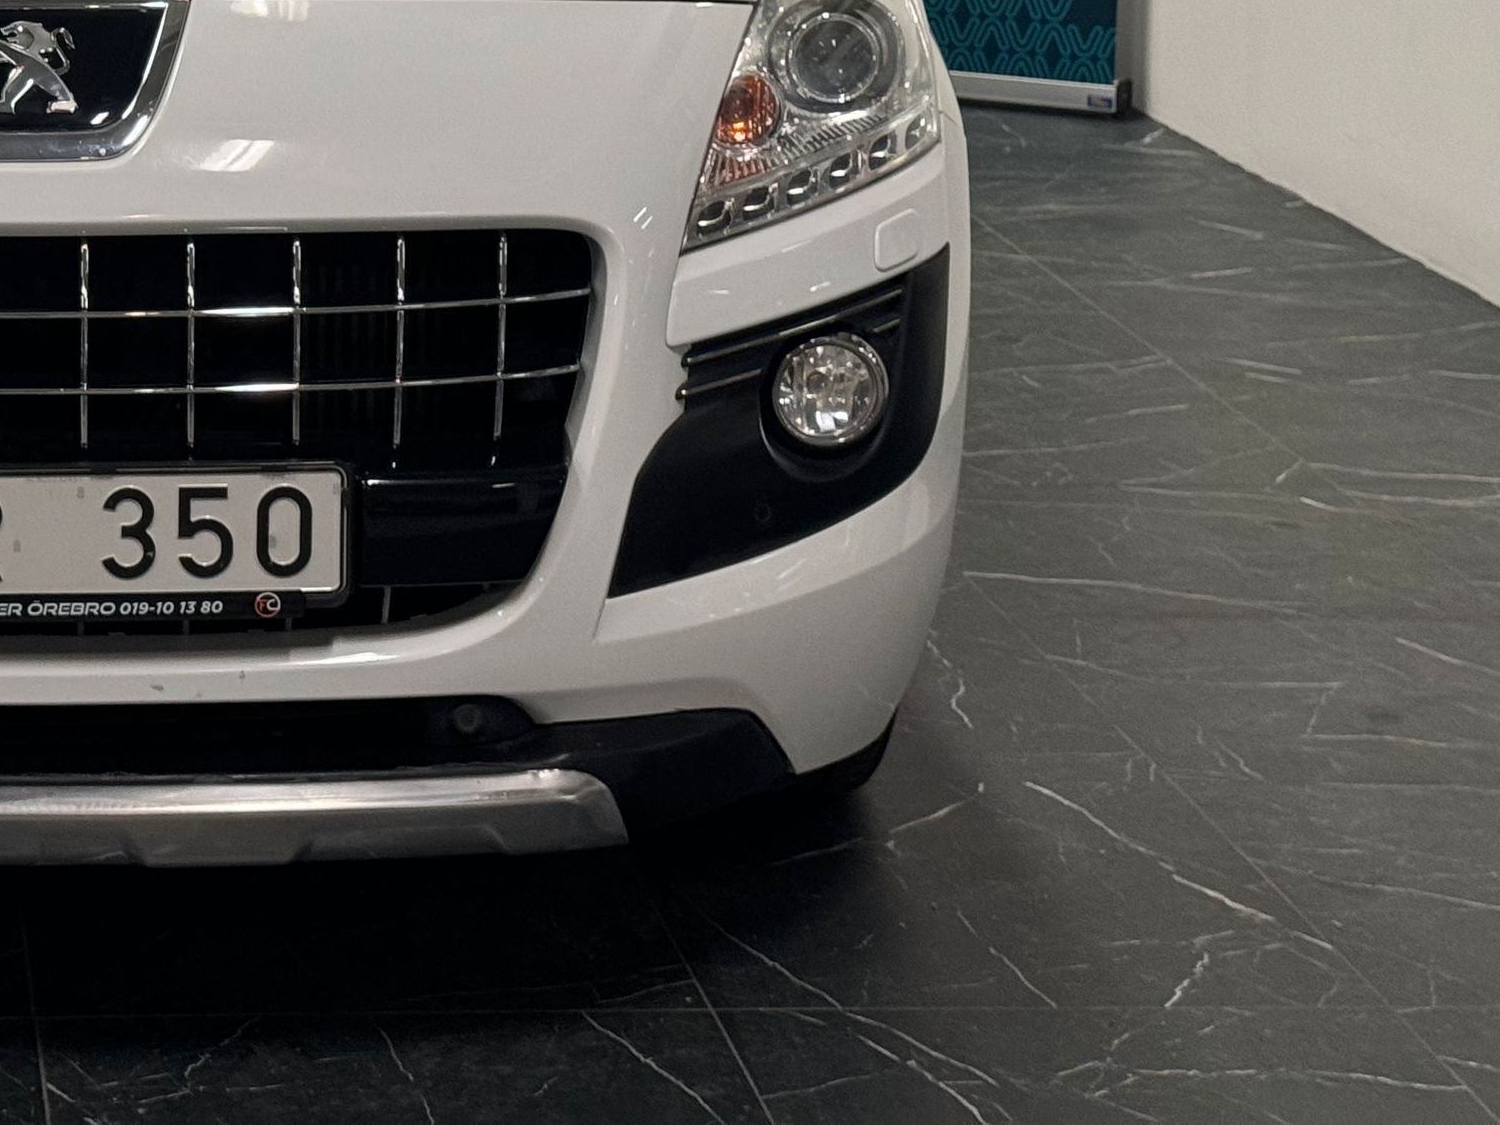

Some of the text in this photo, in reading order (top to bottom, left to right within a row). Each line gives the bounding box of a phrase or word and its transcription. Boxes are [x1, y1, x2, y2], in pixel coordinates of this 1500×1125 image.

[102, 484, 314, 580] 350
[27, 599, 116, 617] ÖREBRO
[119, 601, 175, 616] 019-10
[179, 600, 197, 615] 13
[199, 600, 224, 614] 80
